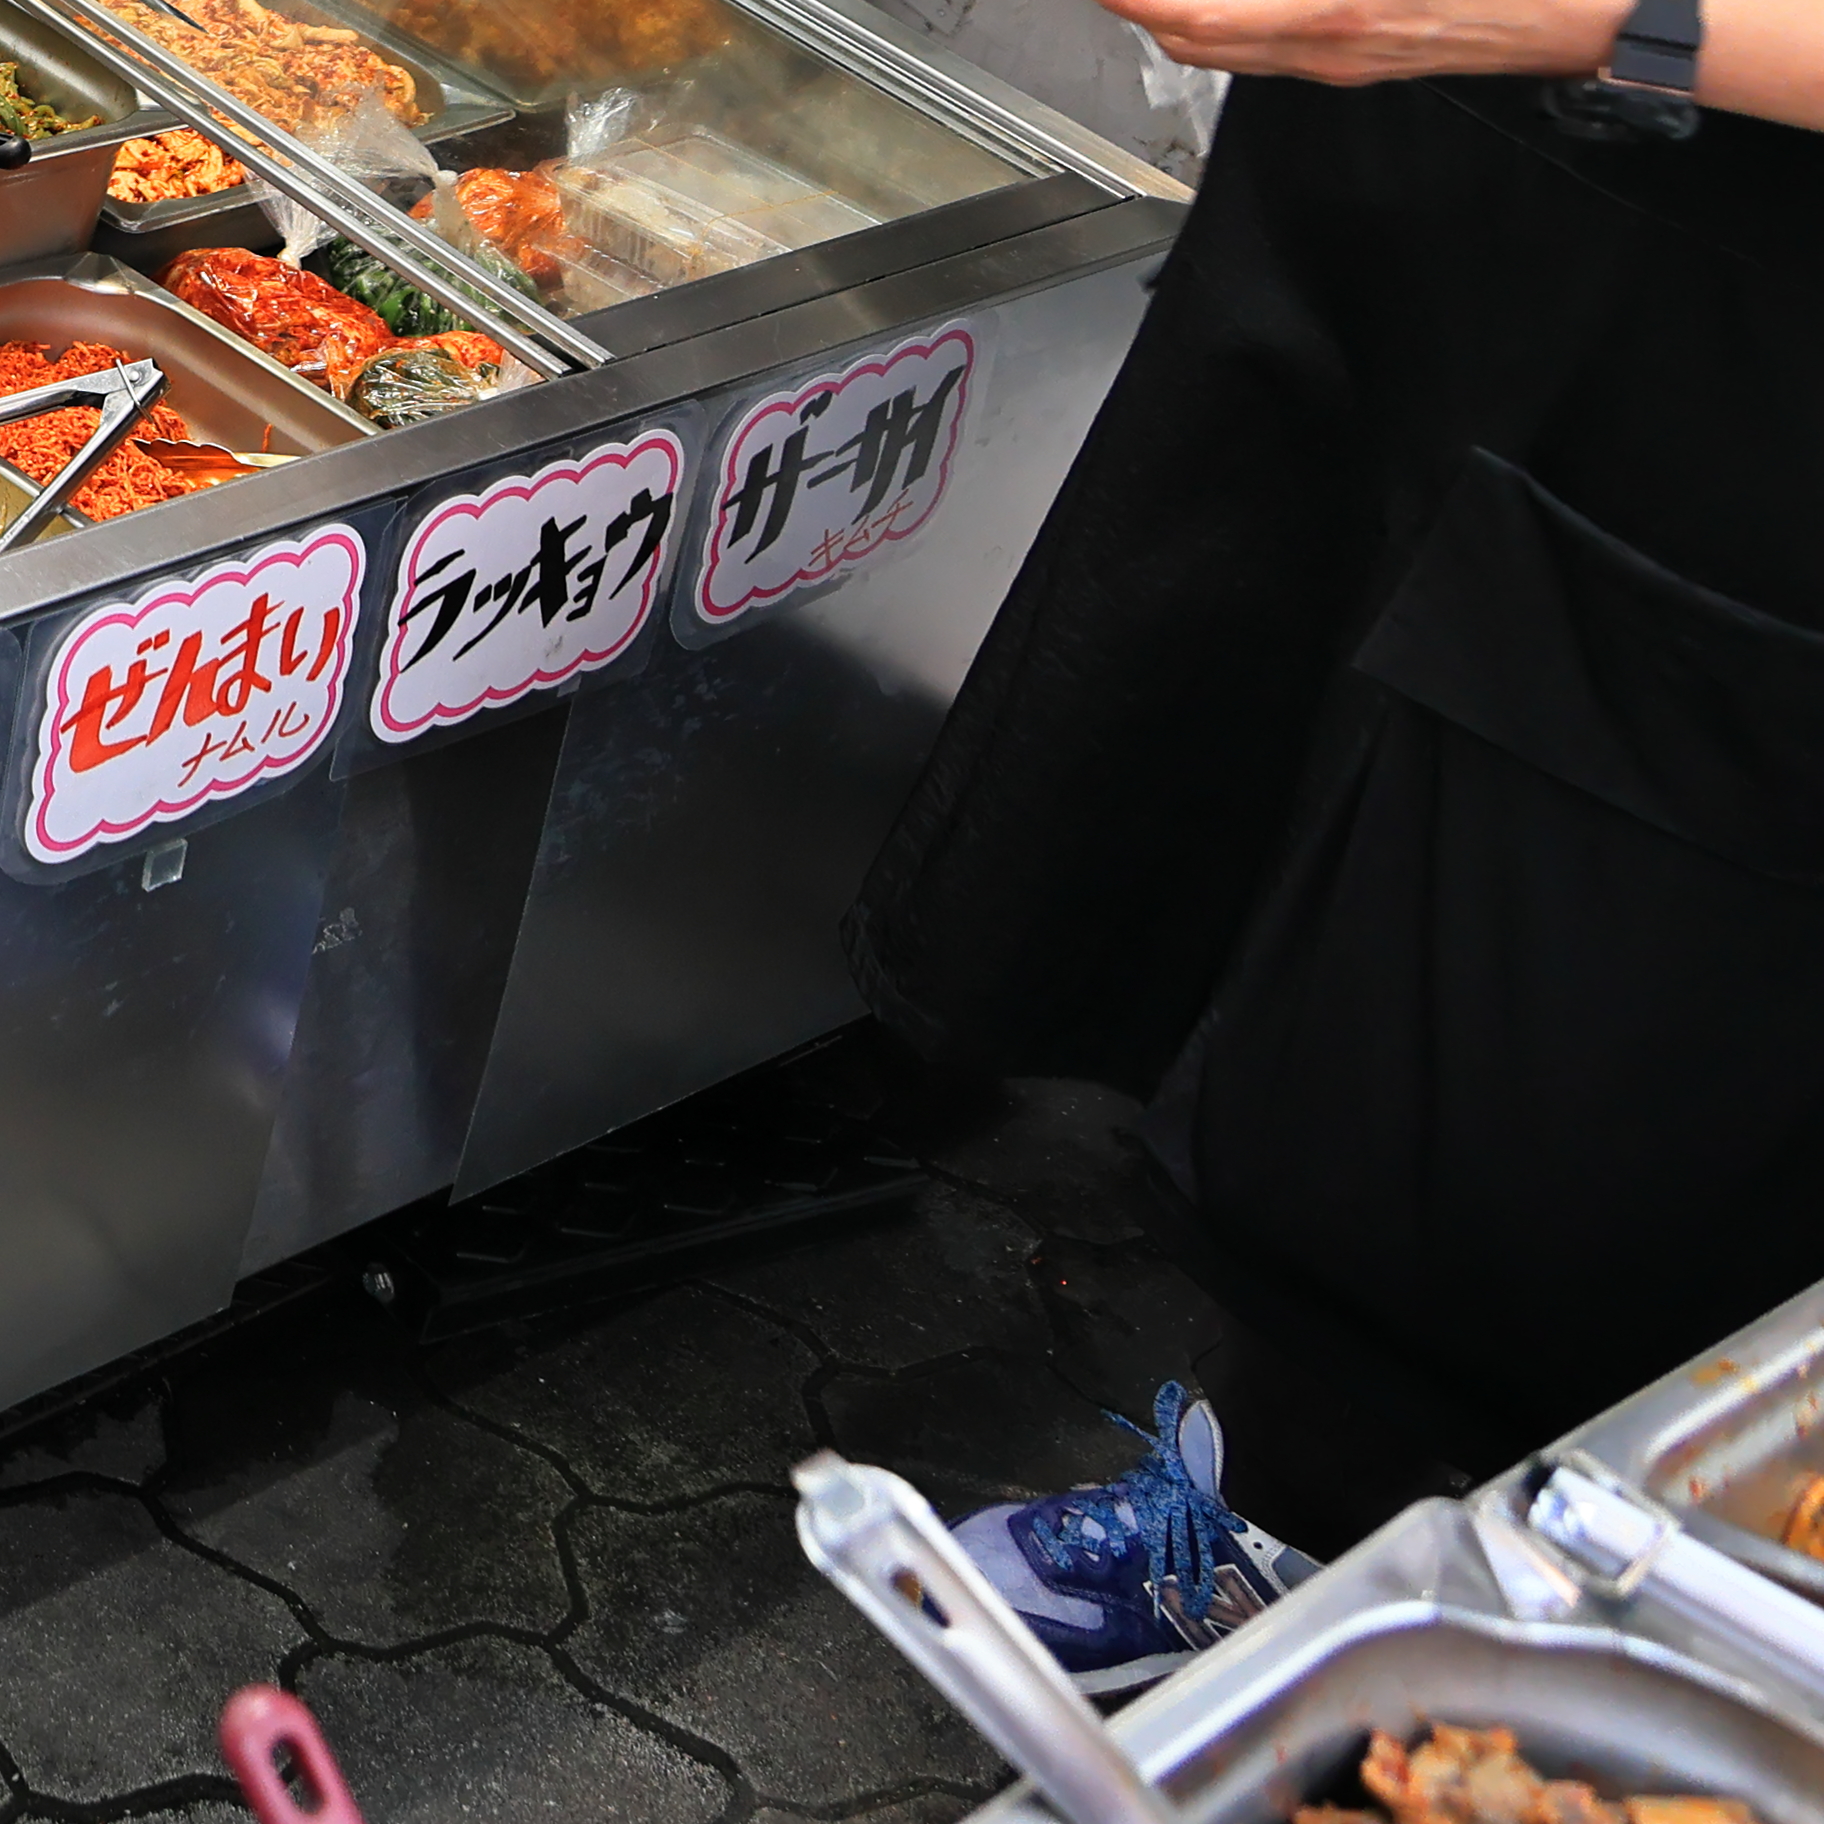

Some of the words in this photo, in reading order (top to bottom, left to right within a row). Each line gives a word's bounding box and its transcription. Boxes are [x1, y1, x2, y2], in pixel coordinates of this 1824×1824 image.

[718, 363, 969, 566] ザーサイ
[809, 492, 915, 573] キムチ
[396, 488, 674, 674] ラッキョウ
[59, 592, 341, 774] ぜんまい
[179, 702, 311, 787] ナムル
